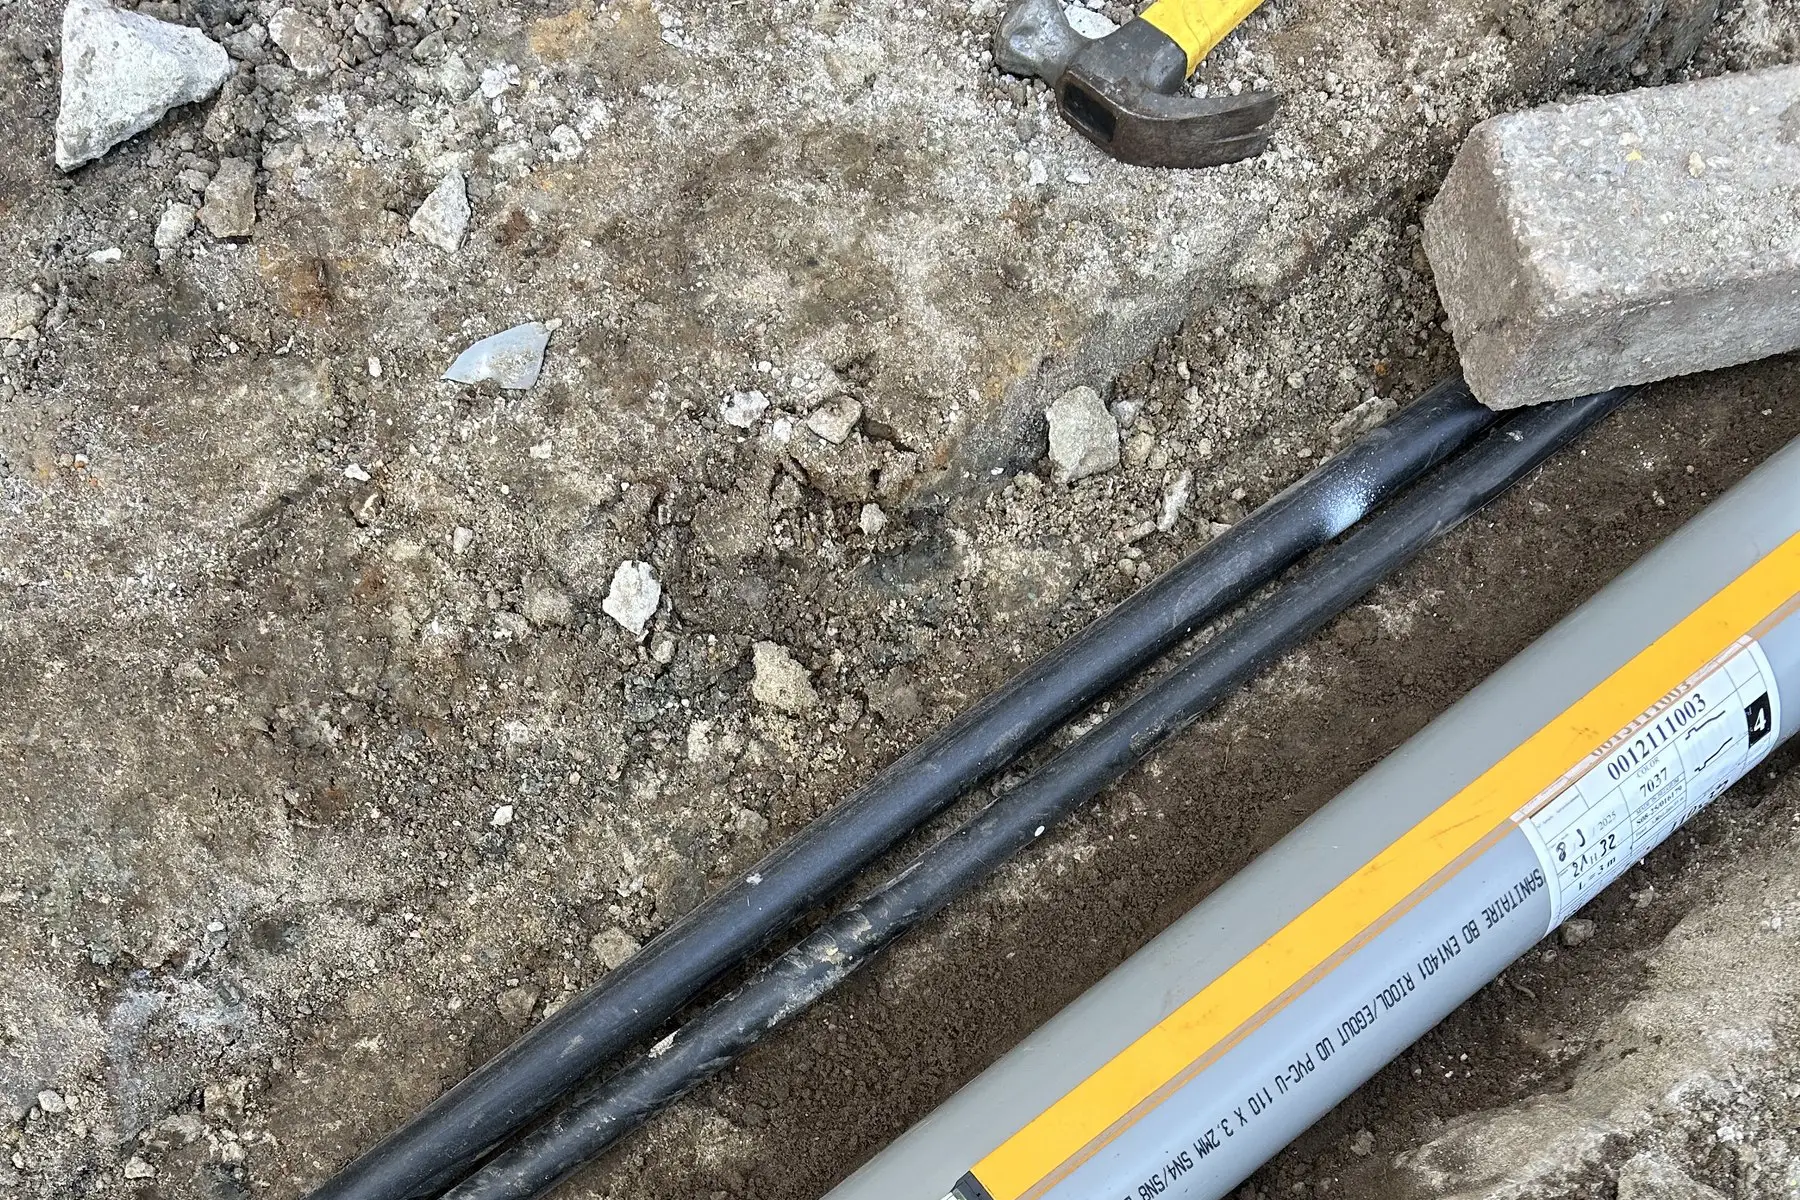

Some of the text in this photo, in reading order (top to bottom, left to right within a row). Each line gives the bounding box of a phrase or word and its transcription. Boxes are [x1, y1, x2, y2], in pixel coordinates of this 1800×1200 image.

[1753, 707, 1766, 731] 4
[1607, 693, 1706, 780] 0012111003
[1636, 757, 1660, 778] COLOR
[1640, 767, 1668, 797] 7037
[1556, 841, 1567, 862] 8
[1598, 811, 1617, 831] 2025
[1417, 935, 1461, 980] EN1401
[1275, 1053, 1315, 1094] PVC-U
[1248, 1087, 1273, 1115] 110
[1233, 1107, 1248, 1127] X
